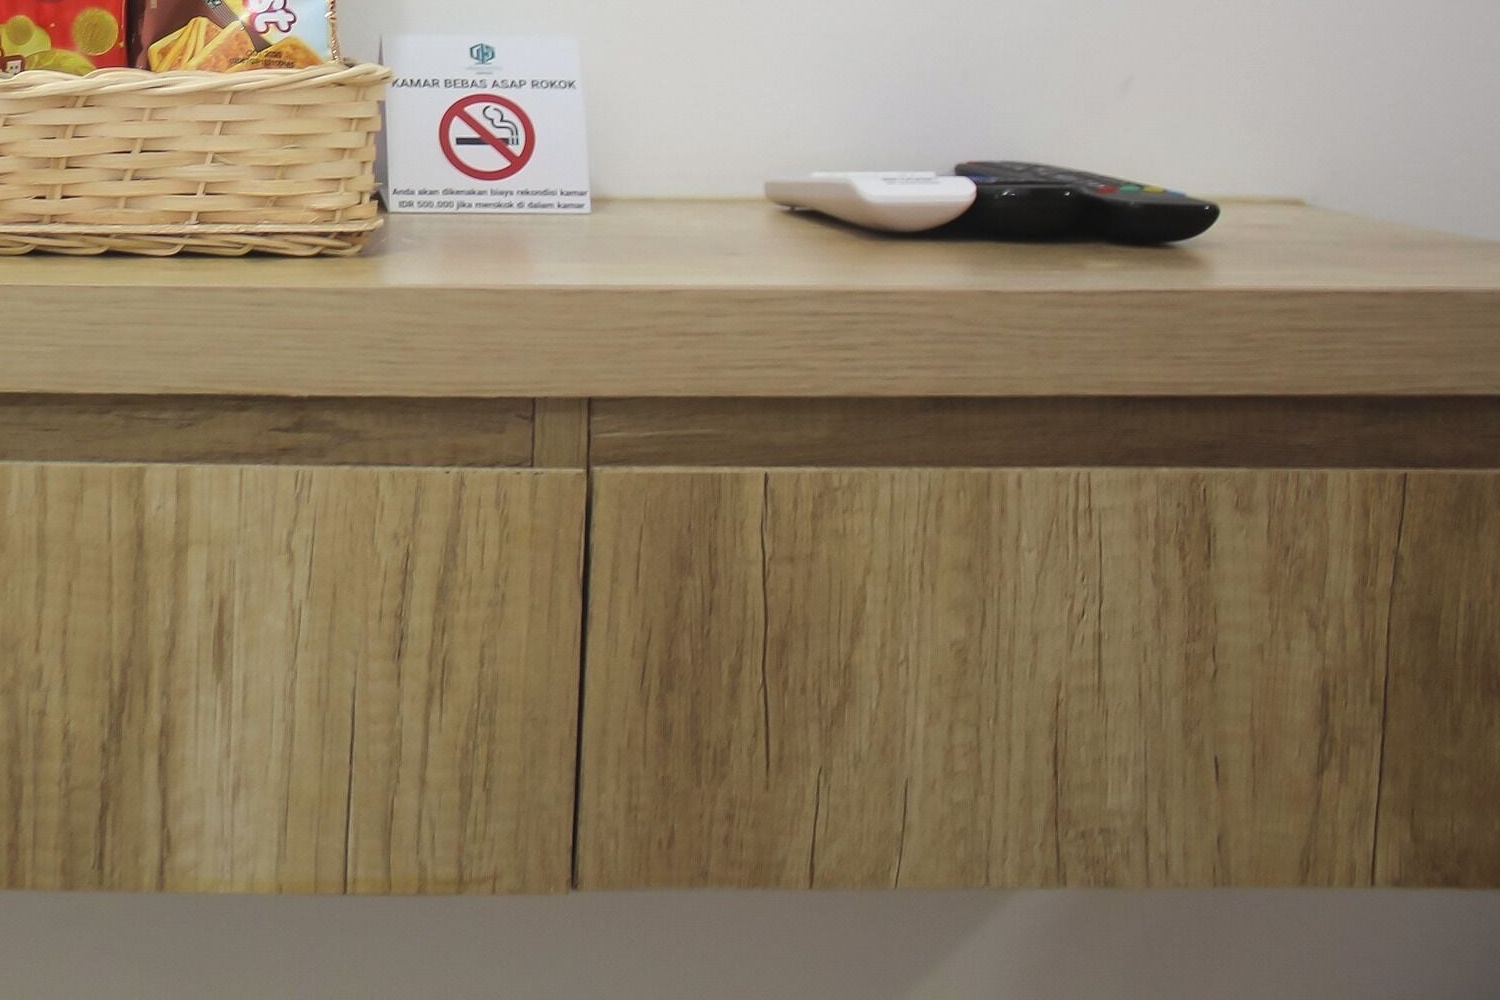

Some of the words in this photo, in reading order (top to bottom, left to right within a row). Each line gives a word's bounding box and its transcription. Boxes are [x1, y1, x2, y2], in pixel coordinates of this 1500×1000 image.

[392, 78, 441, 89] KAMAR
[444, 78, 488, 89] BEBAS
[491, 79, 527, 89] ASAP
[531, 79, 577, 90] ROKOK
[392, 187, 415, 196] Anda
[560, 188, 588, 197] kamar
[557, 200, 585, 210] kamar
